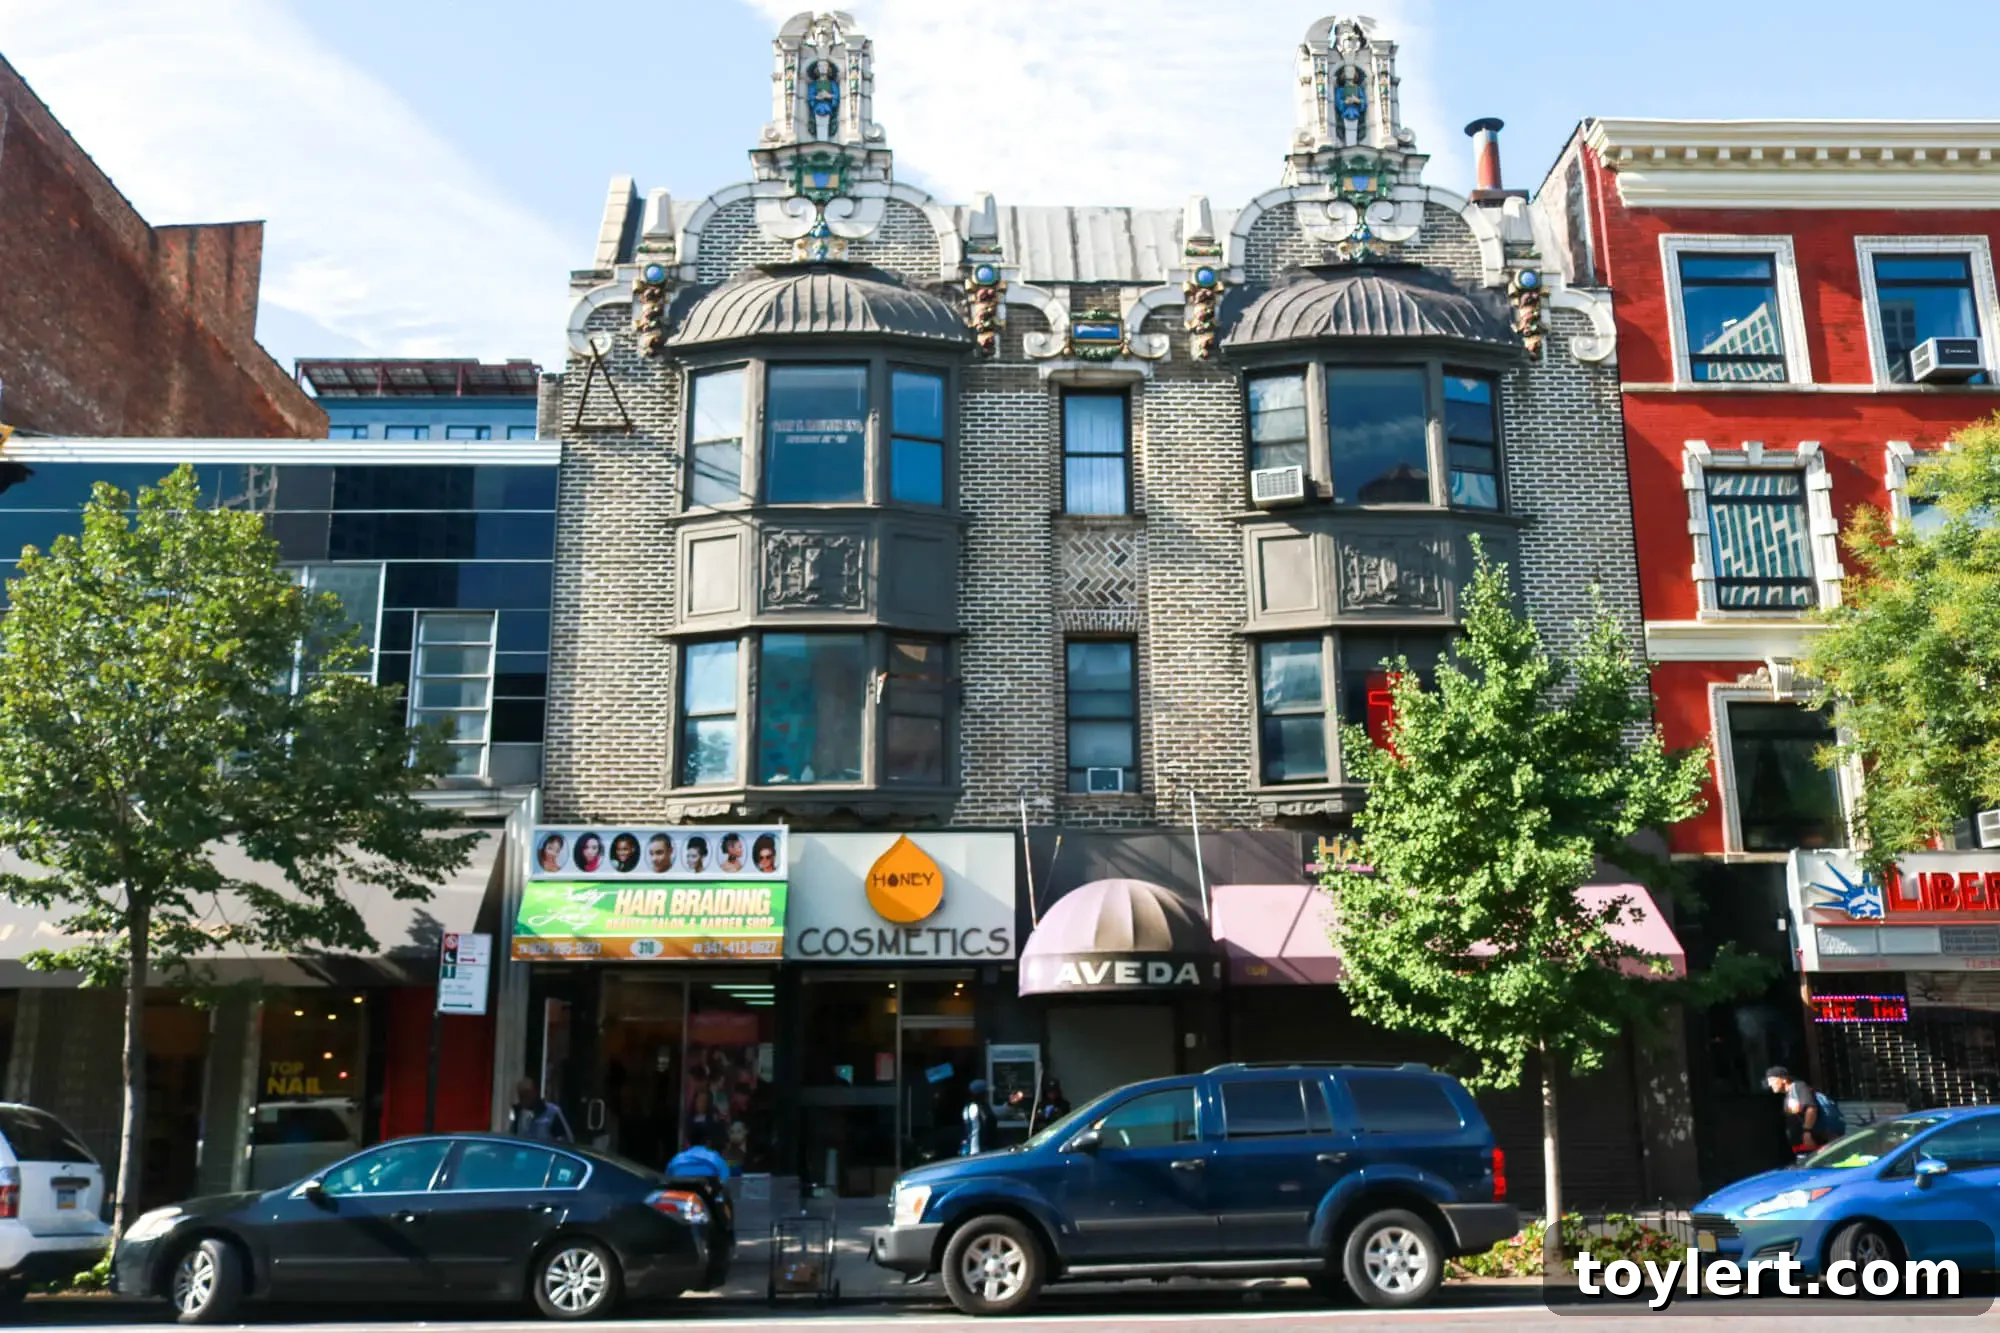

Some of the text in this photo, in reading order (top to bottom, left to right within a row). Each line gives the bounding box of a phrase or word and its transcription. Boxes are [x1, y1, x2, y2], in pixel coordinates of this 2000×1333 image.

[872, 871, 935, 888] HONEY
[613, 888, 667, 917] HAIR
[669, 888, 771, 917] BRAIDING
[796, 927, 1011, 957] COSMETICS
[1057, 961, 1200, 985] AVEDA
[270, 1061, 304, 1075] TOP
[267, 1076, 324, 1096] NAIL
